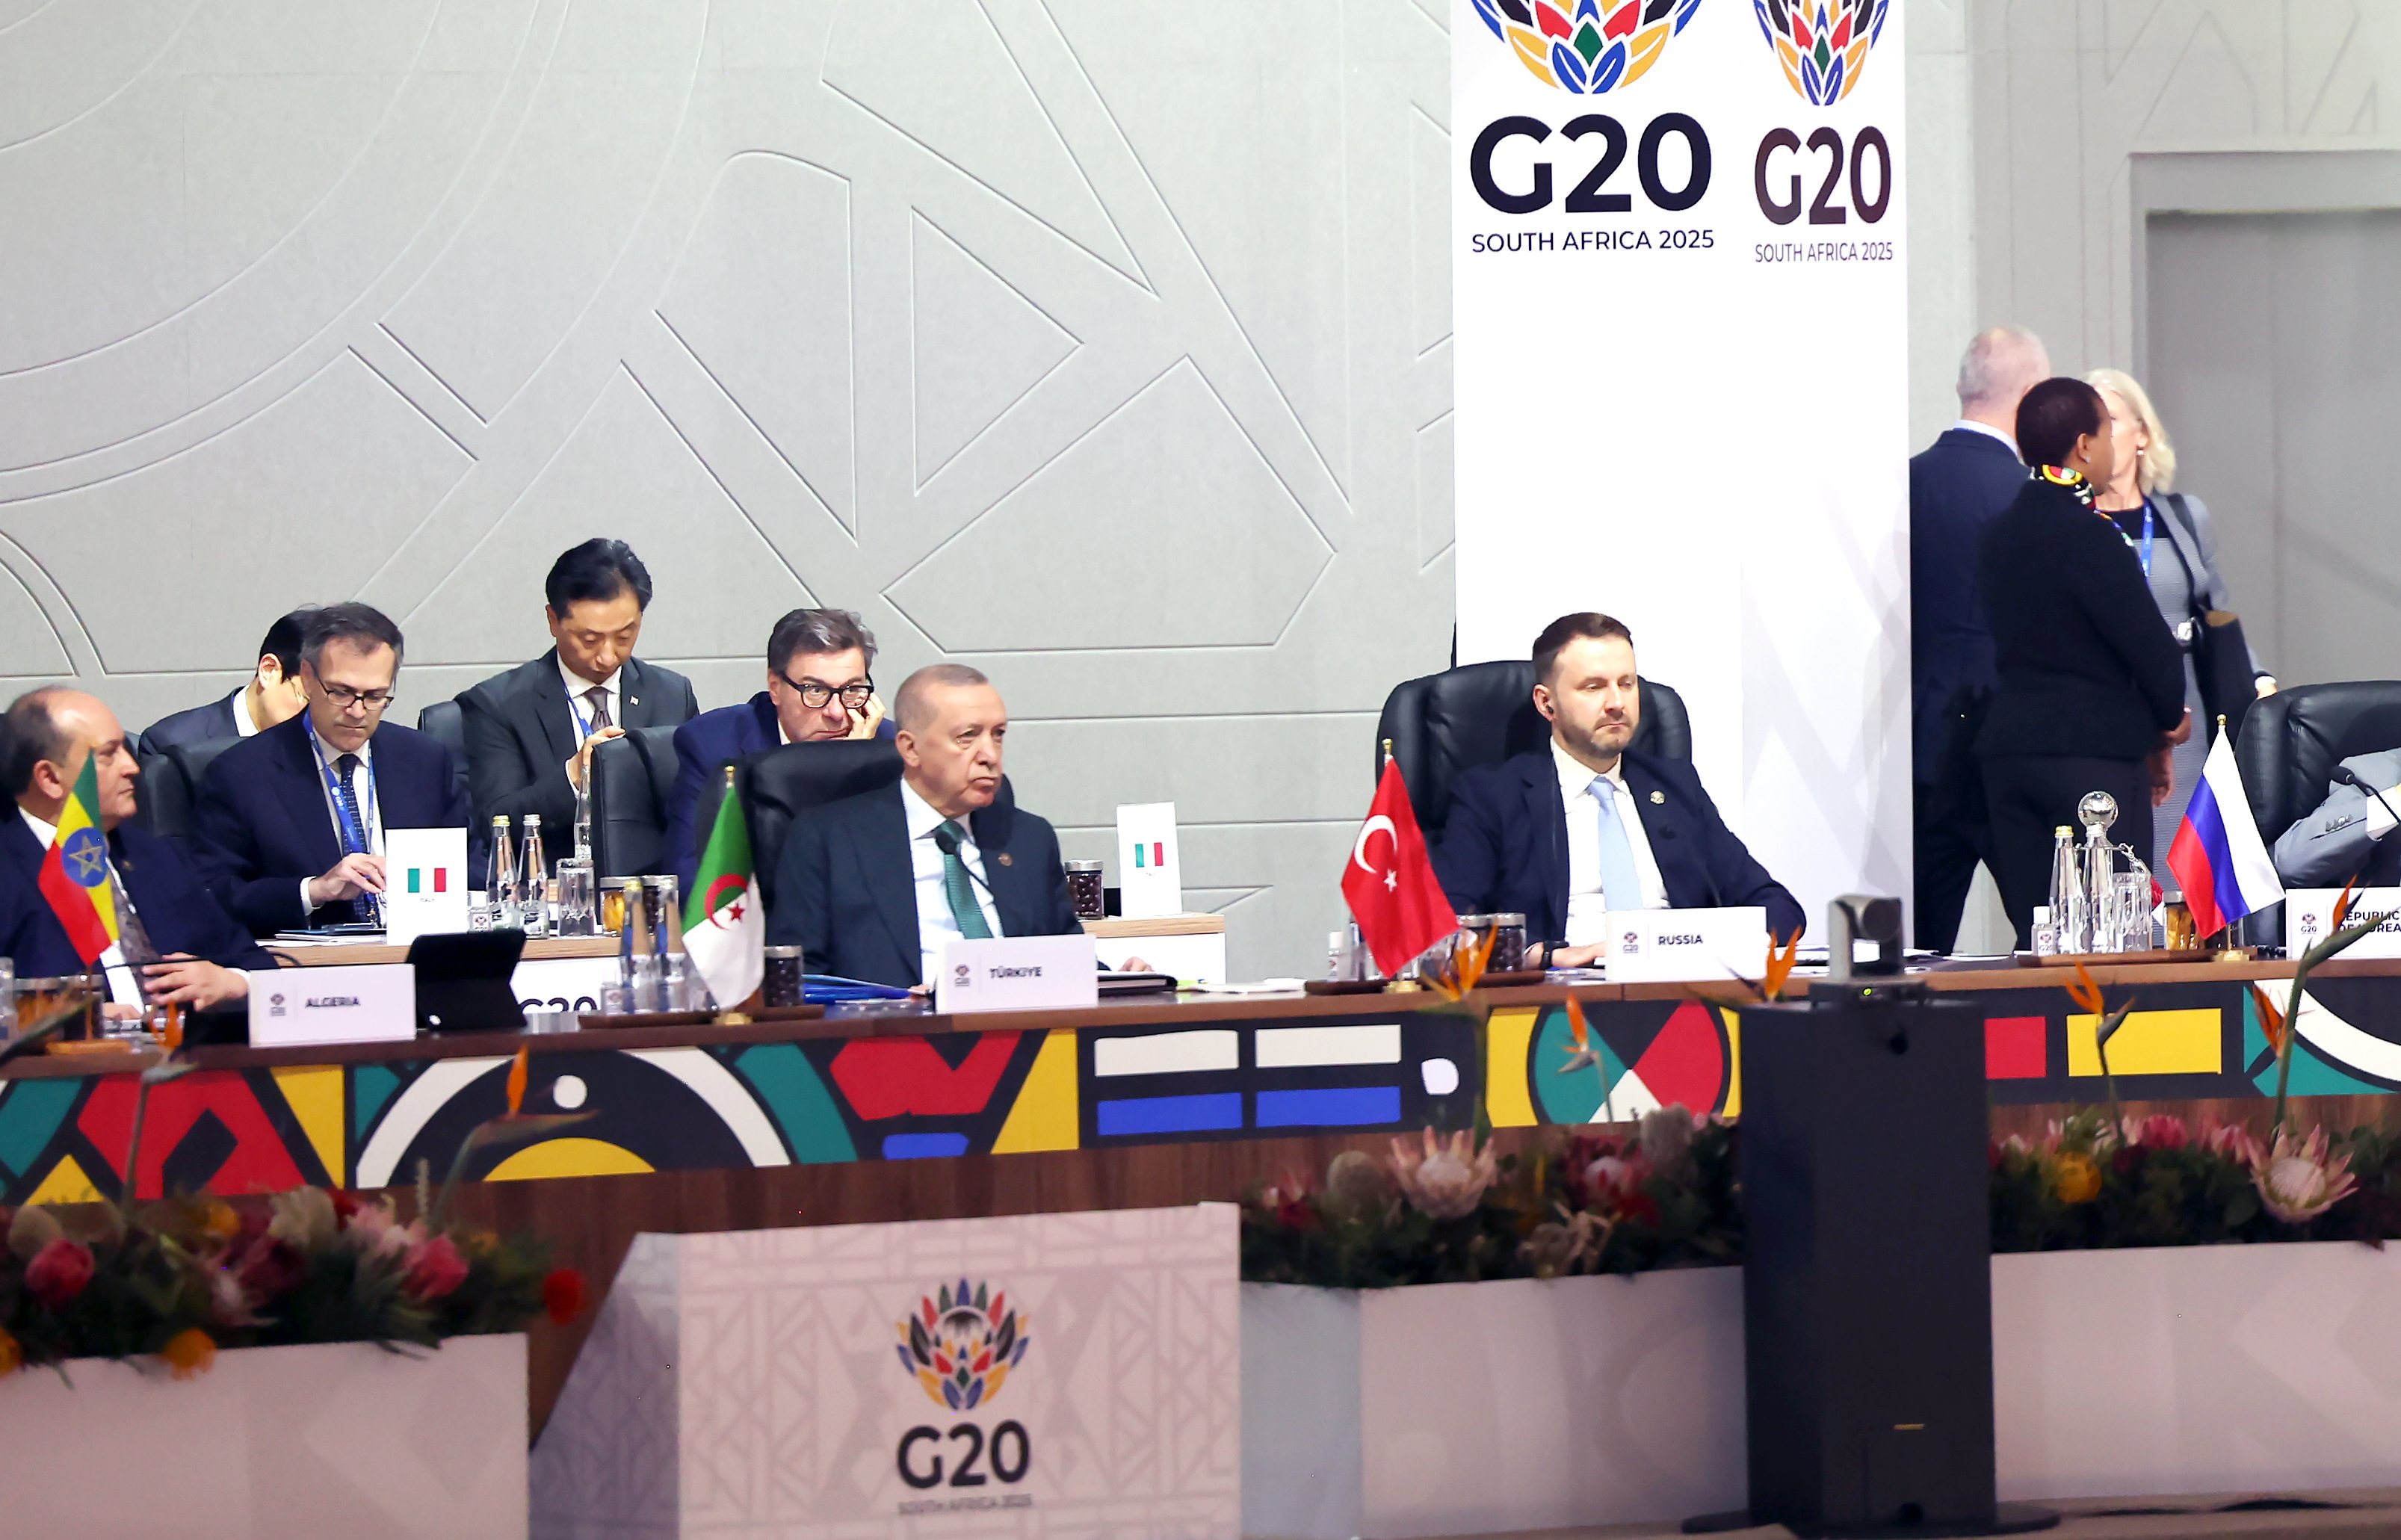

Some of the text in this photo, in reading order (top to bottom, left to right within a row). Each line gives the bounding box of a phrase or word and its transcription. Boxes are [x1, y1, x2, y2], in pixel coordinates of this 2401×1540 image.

[1470, 112, 1711, 214] G20
[1755, 126, 1891, 226] G20
[1472, 229, 1714, 253] SOUTH AFRICA 2025
[1755, 241, 1893, 262] SOUTH AFRICA 2025
[1658, 934, 1703, 945] RUSSIA
[305, 996, 361, 1007] ALGERIA
[897, 1419, 1030, 1489] G20
